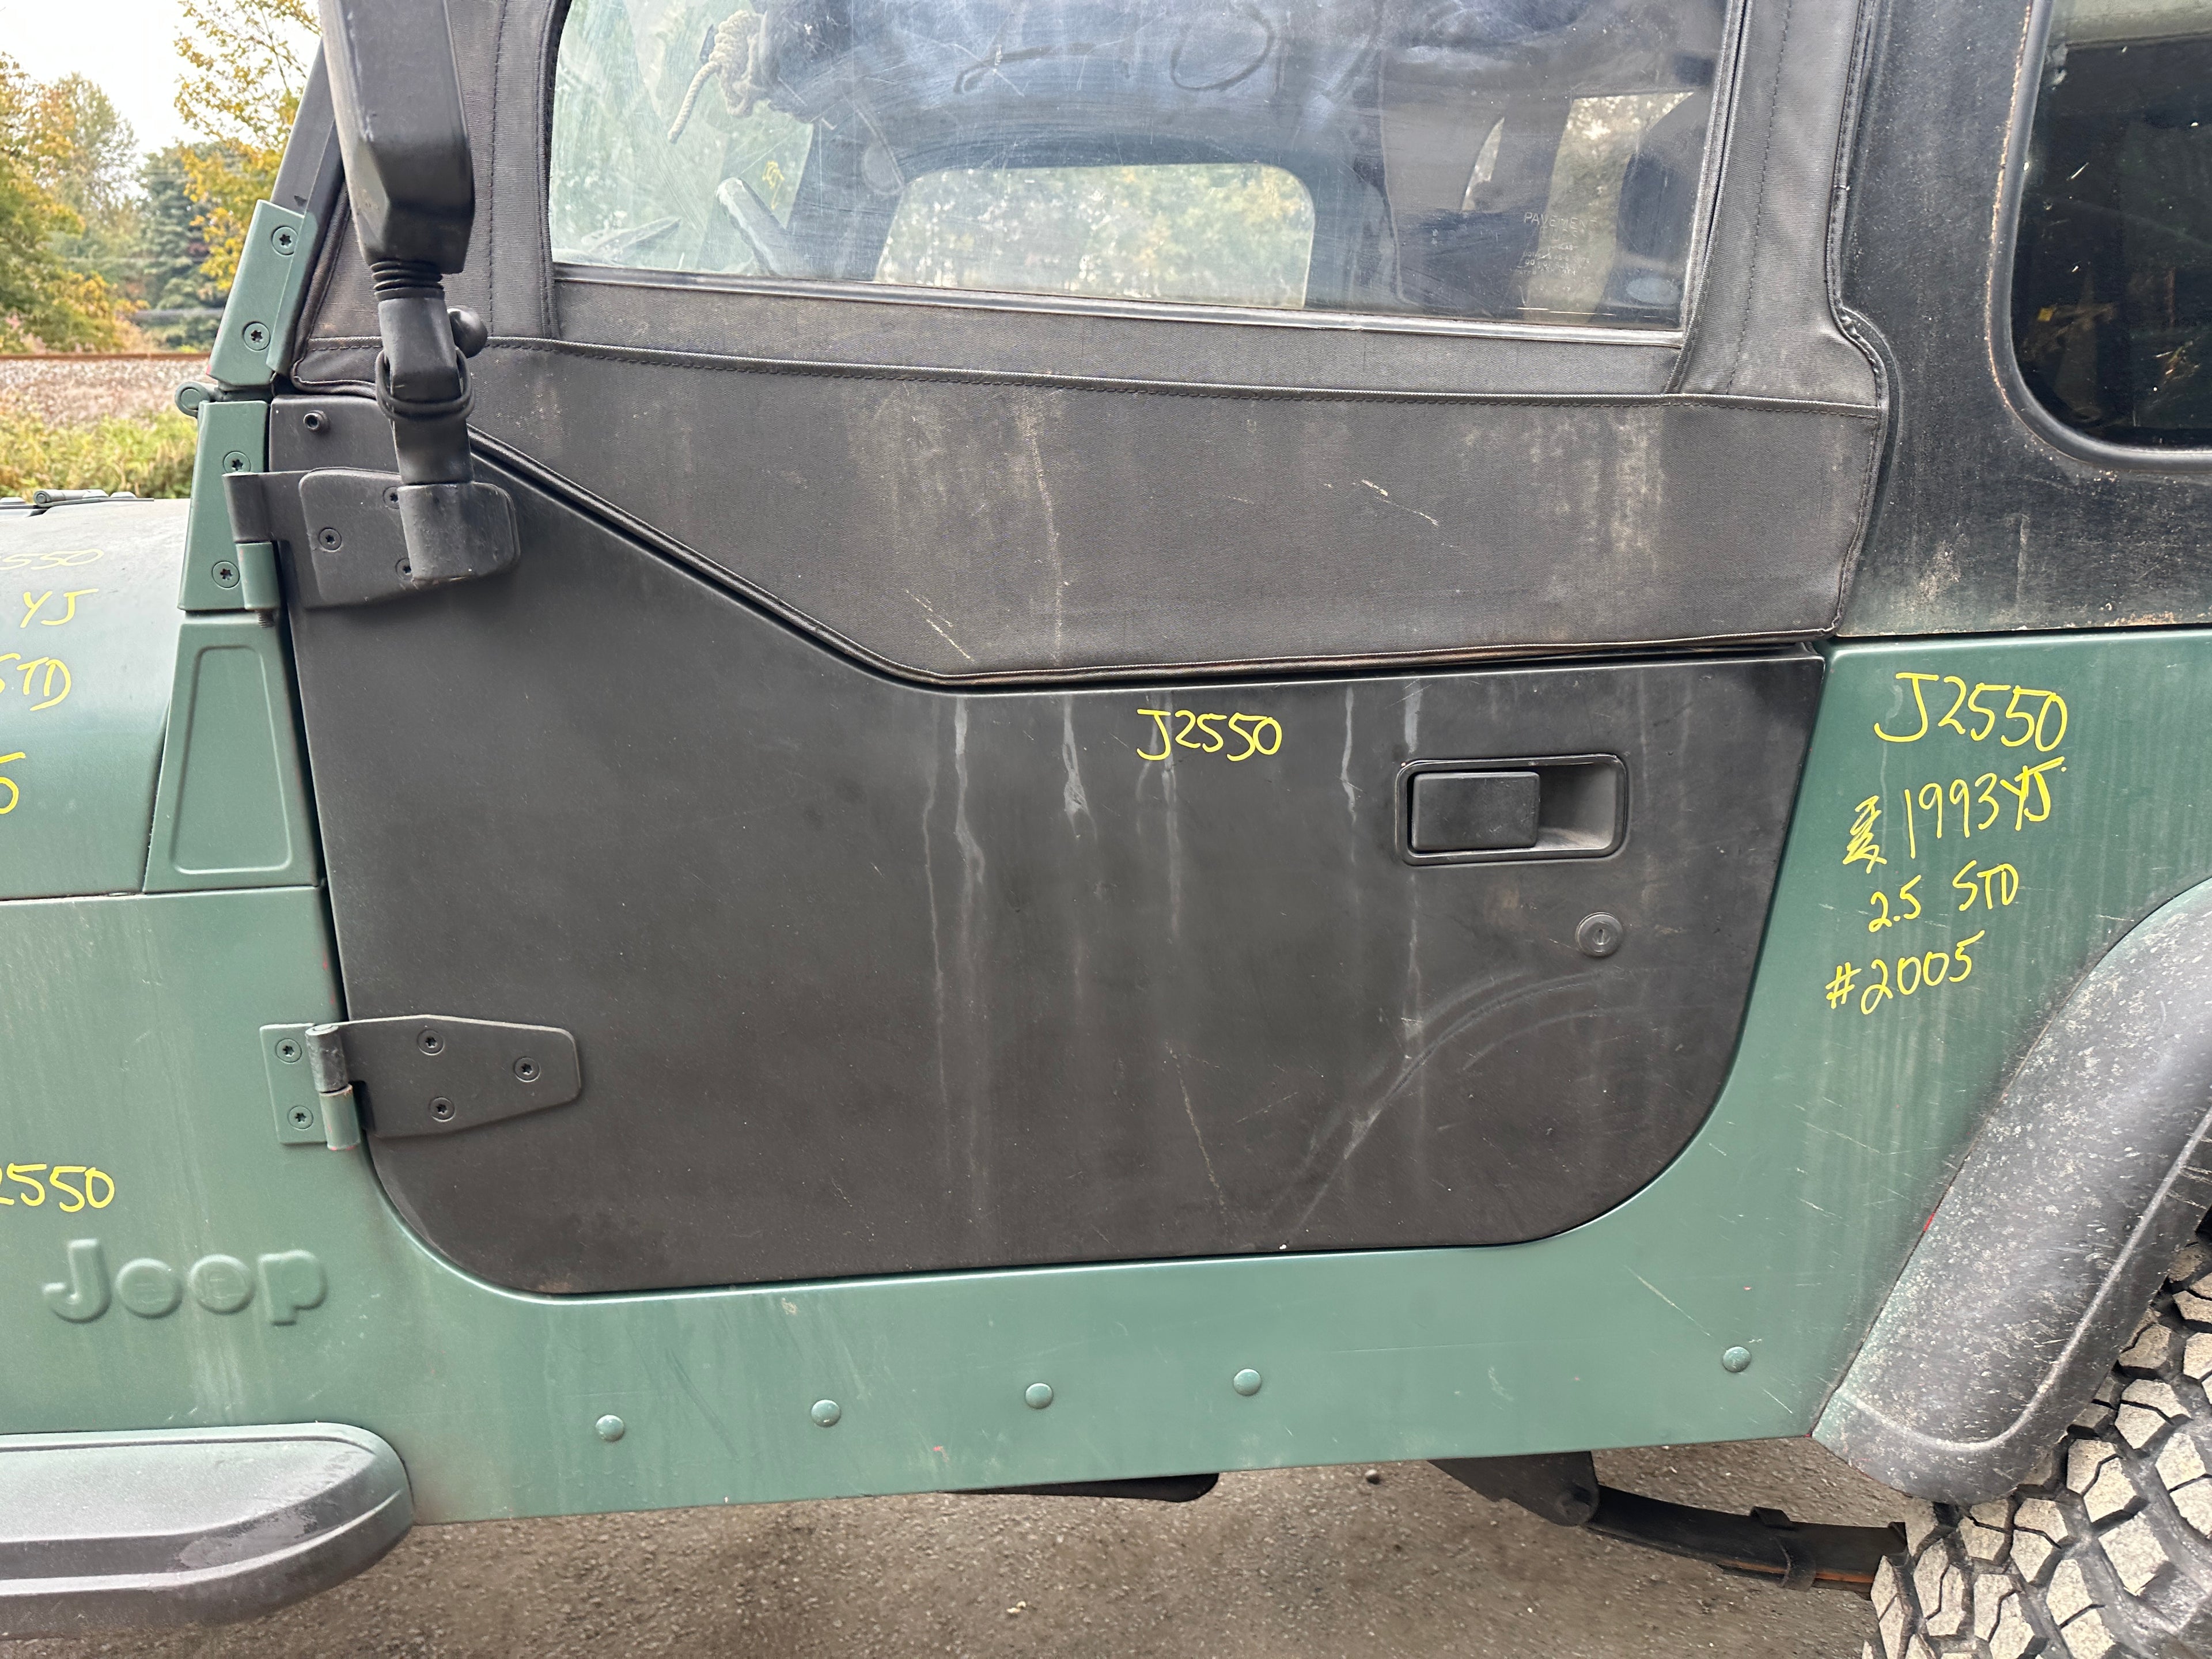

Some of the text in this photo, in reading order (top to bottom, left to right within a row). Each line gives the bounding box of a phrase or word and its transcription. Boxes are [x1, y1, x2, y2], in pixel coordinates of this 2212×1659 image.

[0, 548, 104, 570] 550
[20, 588, 99, 628] YJ
[1137, 709, 1282, 762] J2550
[1873, 672, 2068, 752] J2550
[1867, 859, 2019, 933] 2.5 STD
[1825, 930, 1985, 1014] #2005
